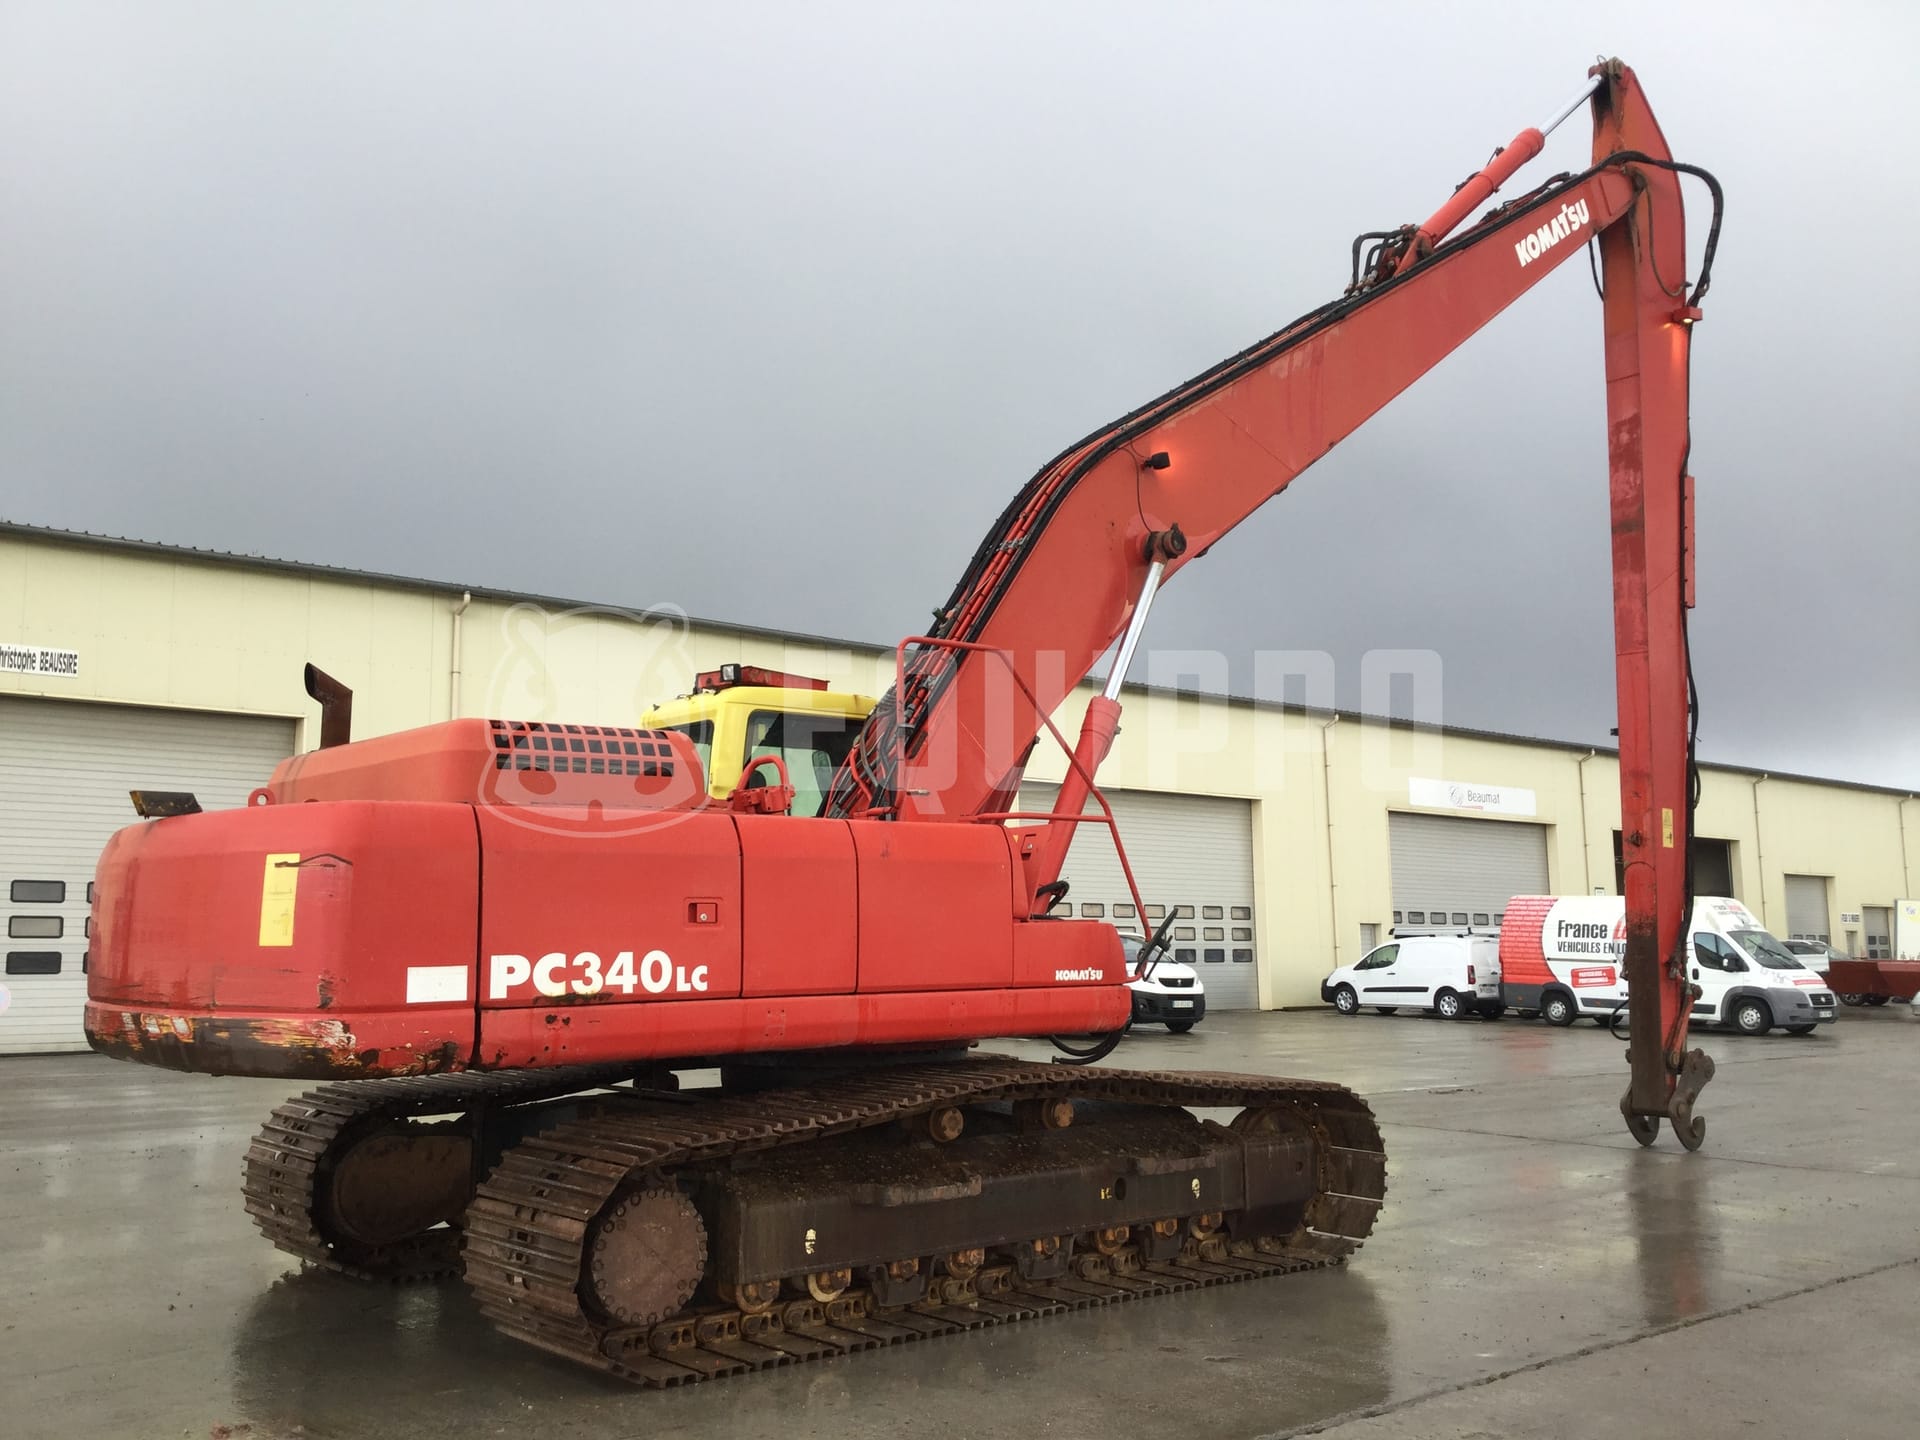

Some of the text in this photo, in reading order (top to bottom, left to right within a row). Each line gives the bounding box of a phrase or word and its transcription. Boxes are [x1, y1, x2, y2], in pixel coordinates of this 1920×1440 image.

[1514, 198, 1590, 268] KOMATSU
[40, 651, 78, 674] BEAUSSIRE
[1467, 789, 1500, 804] Beaumat
[1557, 919, 1608, 939] France
[1557, 941, 1601, 953] VEHICULES
[1603, 942, 1615, 954] EN
[1055, 966, 1103, 981] KOMATSU
